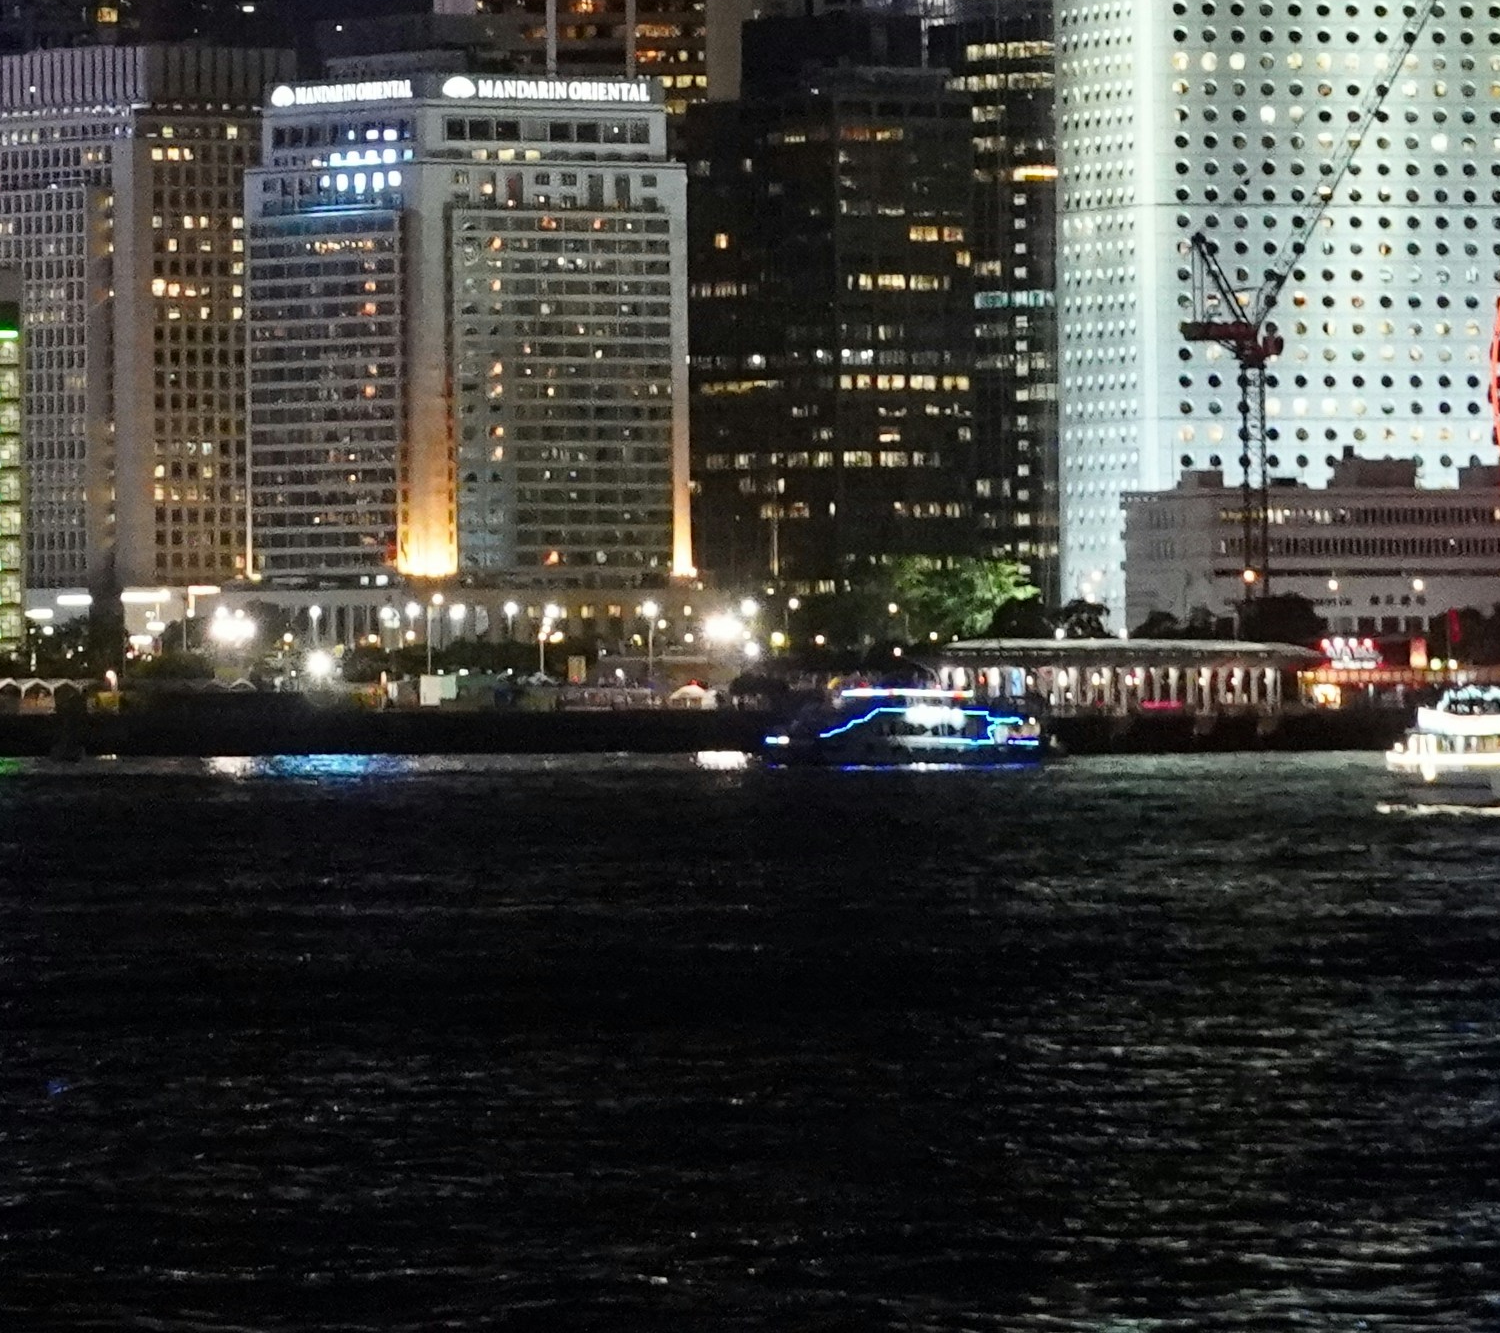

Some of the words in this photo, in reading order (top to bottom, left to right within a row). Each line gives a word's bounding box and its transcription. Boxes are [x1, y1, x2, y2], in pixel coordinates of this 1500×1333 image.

[295, 83, 356, 105] MANDARIN
[356, 79, 413, 101] ORIENTAL
[478, 79, 567, 99] MANDARIN
[568, 81, 650, 101] ORIENTAL
